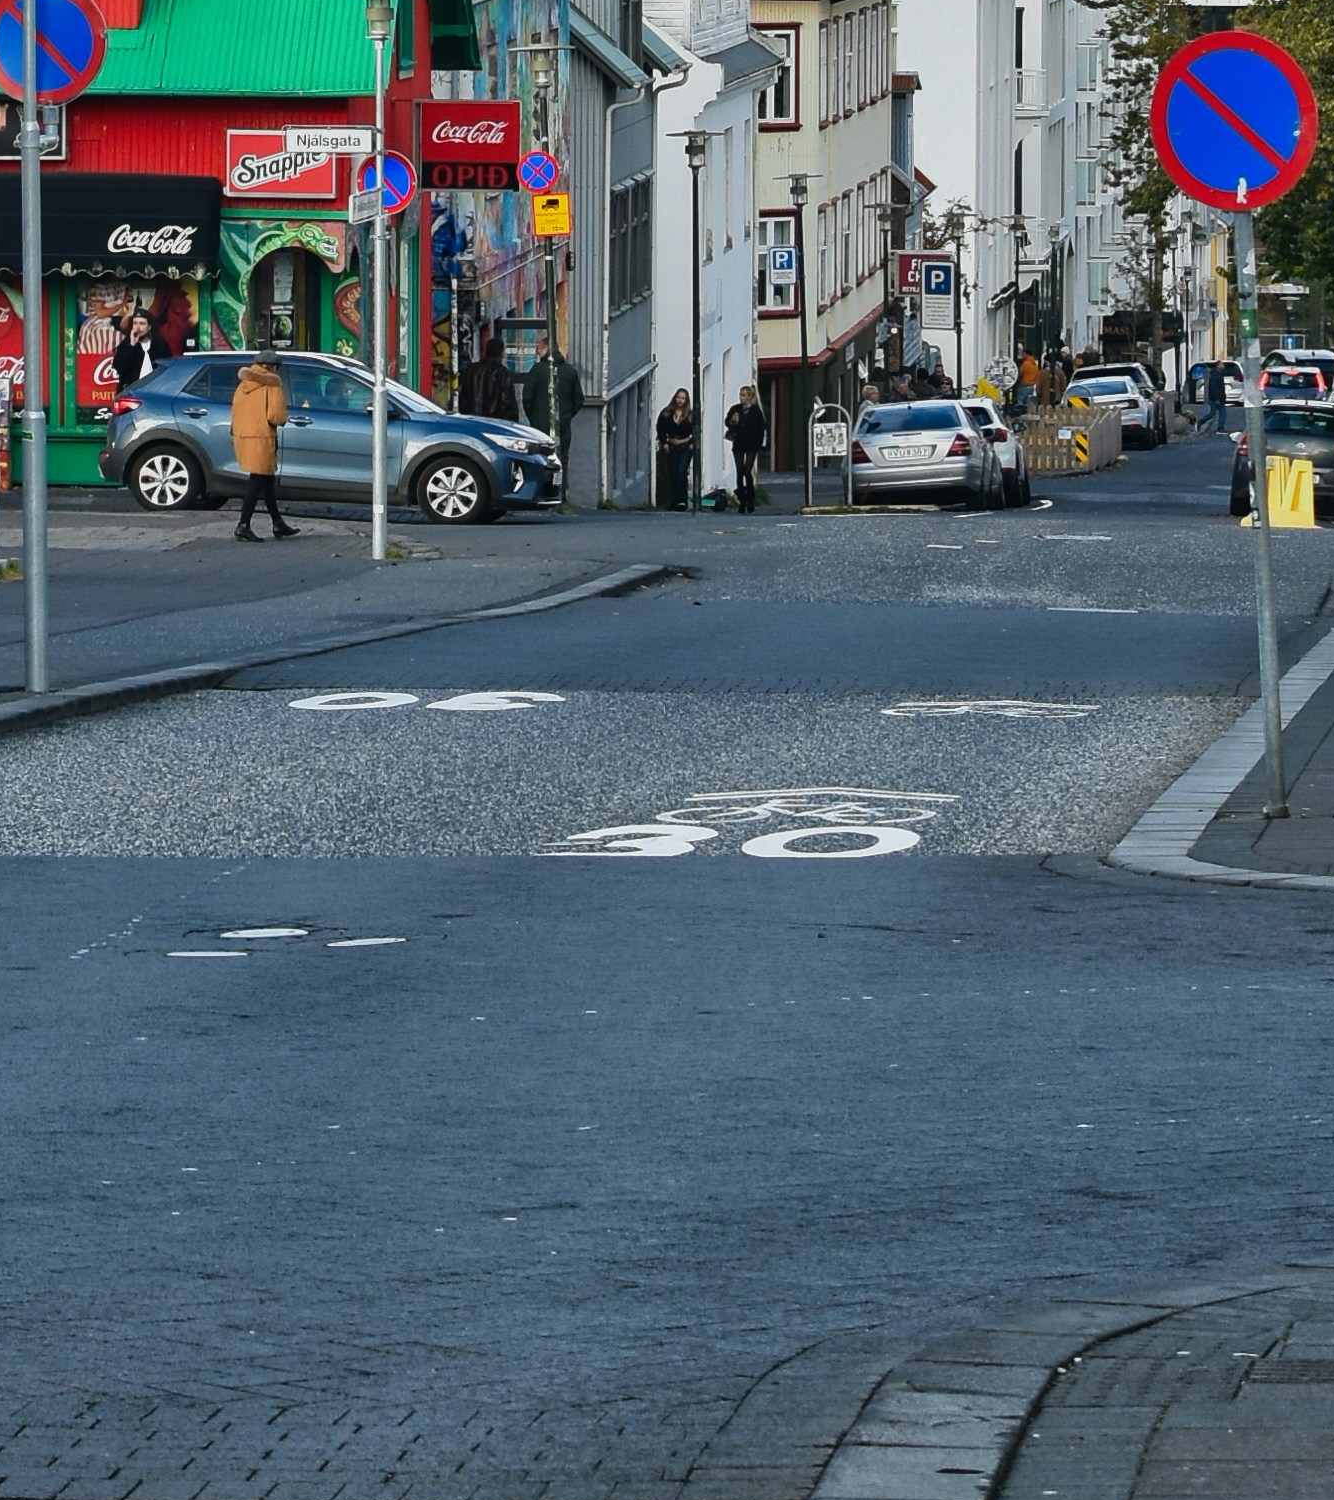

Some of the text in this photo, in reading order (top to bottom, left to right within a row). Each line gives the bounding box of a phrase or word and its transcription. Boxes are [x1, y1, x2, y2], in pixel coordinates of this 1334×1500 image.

[296, 134, 361, 149] Njálsgata
[431, 120, 509, 144] Coca-Cola
[432, 165, 509, 188] OPIÐ
[108, 224, 198, 256] Coca-Cola
